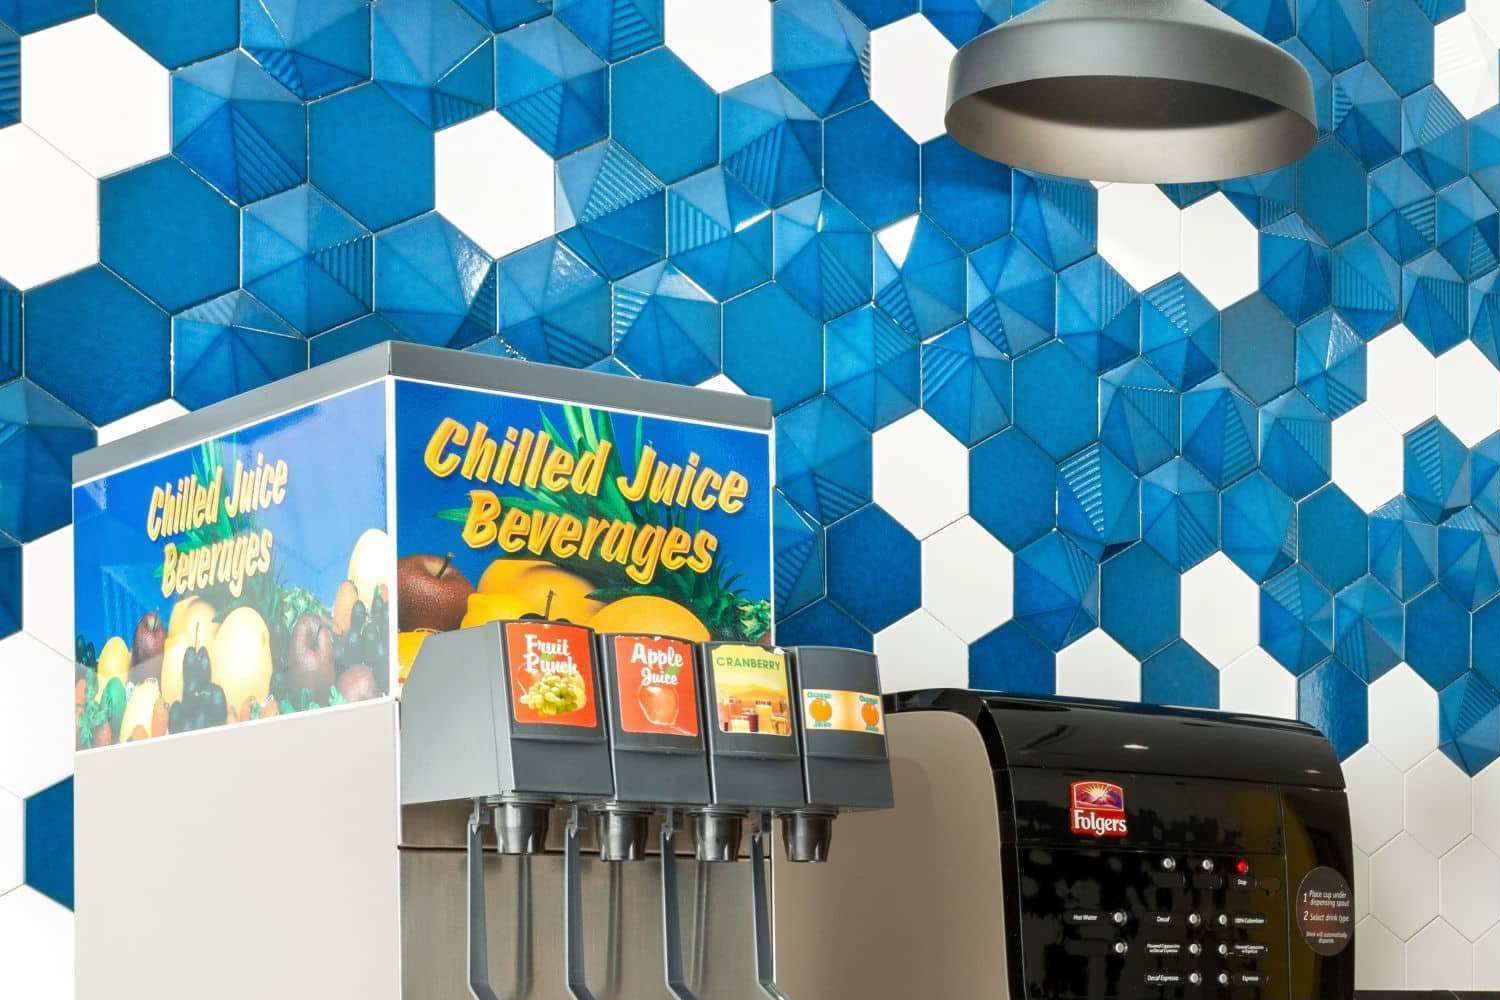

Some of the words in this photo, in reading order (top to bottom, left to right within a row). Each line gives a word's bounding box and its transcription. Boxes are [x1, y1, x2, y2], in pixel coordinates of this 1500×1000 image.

[423, 417, 613, 497] Chilled
[617, 443, 748, 514] Juice
[147, 465, 224, 542] Chilled
[224, 452, 288, 518] Juice
[462, 489, 718, 585] Beverages
[161, 528, 273, 598] Beverages
[524, 633, 570, 656] Fruit
[630, 643, 684, 670] Apple
[523, 652, 578, 674] Punch
[640, 666, 679, 686] Juice
[716, 656, 781, 671] CRANBERRY
[1073, 809, 1127, 836] Folgers
[1303, 910, 1309, 920] 2
